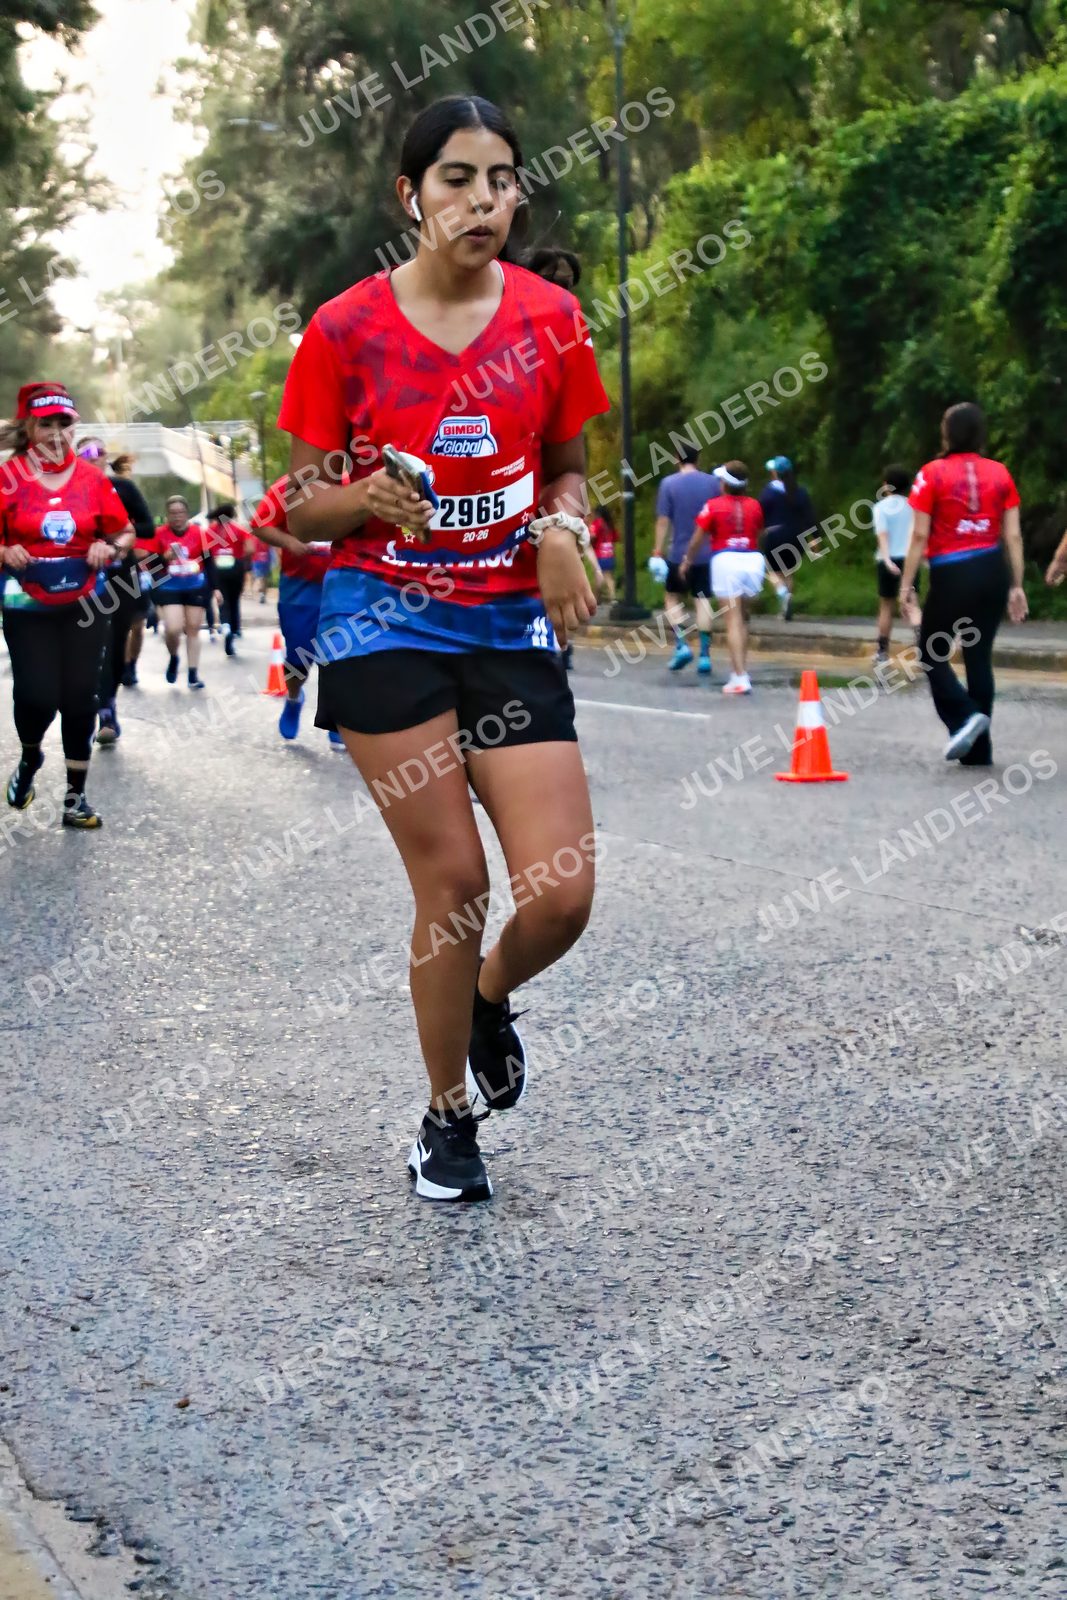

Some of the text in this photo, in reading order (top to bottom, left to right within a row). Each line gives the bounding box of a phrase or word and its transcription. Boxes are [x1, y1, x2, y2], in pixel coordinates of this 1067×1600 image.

[443, 424, 483, 435] BIMBO
[443, 439, 481, 454] Global
[440, 491, 505, 527] 2965
